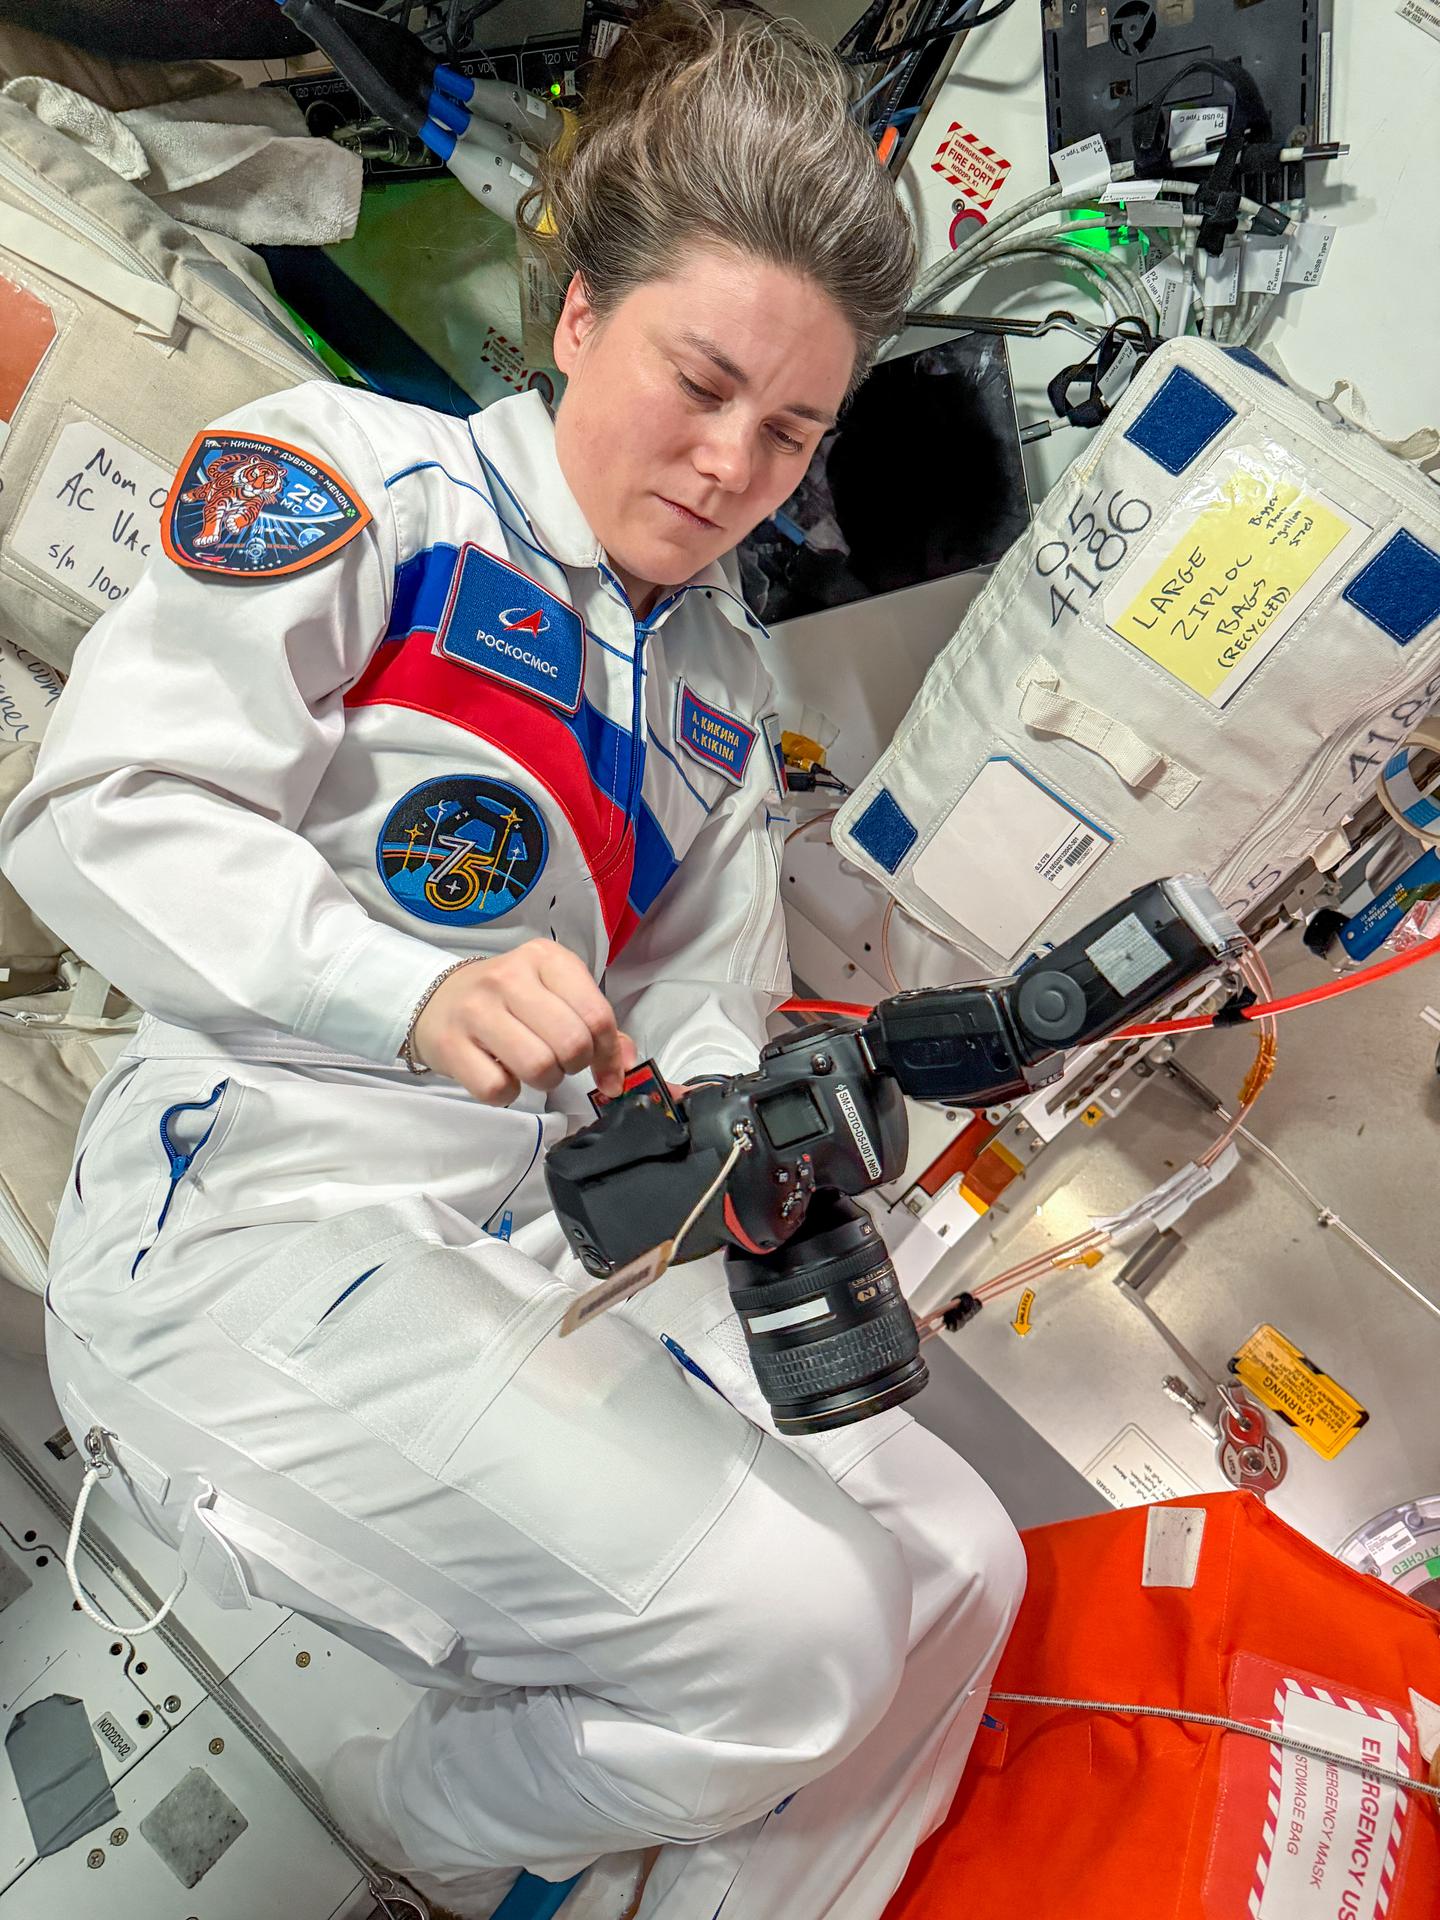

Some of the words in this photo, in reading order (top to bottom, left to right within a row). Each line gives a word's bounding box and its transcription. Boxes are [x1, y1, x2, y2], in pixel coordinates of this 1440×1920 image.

[462, 63, 475, 75] 20
[544, 51, 562, 65] 120
[565, 50, 579, 63] VD
[1214, 119, 1223, 127] P1
[954, 140, 986, 166] EMERGENCY
[985, 163, 997, 175] USE
[1079, 142, 1092, 152] USB
[1093, 145, 1103, 153] P1
[948, 148, 968, 168] FIRE
[968, 163, 992, 185] PORT
[1312, 257, 1322, 273] USB
[1317, 241, 1328, 258] Type
[1148, 282, 1158, 295] USB
[1149, 270, 1158, 281] P2
[1266, 280, 1273, 290] P2
[1303, 270, 1312, 282] P2
[85, 448, 136, 496] Nom
[57, 472, 94, 511] AC
[287, 484, 328, 513] 29
[323, 480, 350, 509] MENON
[1050, 489, 1152, 628] 4186
[1132, 546, 1206, 630] LARGE
[1171, 555, 1252, 641] ZIPLOC
[1217, 578, 1266, 636] BAGS
[1217, 586, 1291, 668] (RECYCLED)
[476, 630, 559, 678] РОСКОСМОС
[7, 639, 61, 707] cuum
[0, 685, 29, 742] ner
[701, 716, 739, 749] КИКИНА
[701, 733, 735, 762] KIKINA
[425, 834, 495, 911] 75
[839, 1092, 872, 1158] SM-FOTO-D5-U01
[1261, 1376, 1315, 1426] WARNING
[1227, 1455, 1237, 1476] LATCH
[1392, 1545, 1440, 1575] ATCHED
[97, 1718, 130, 1756] NOD2D3-02
[1292, 1754, 1309, 1820] STOWAGE
[1323, 1761, 1339, 1841] MERGENCY
[1348, 1737, 1381, 1887] EMERGENCY
[1287, 1822, 1304, 1856] BAG
[1310, 1841, 1331, 1890] MASK
[1338, 1889, 1360, 1920] US
